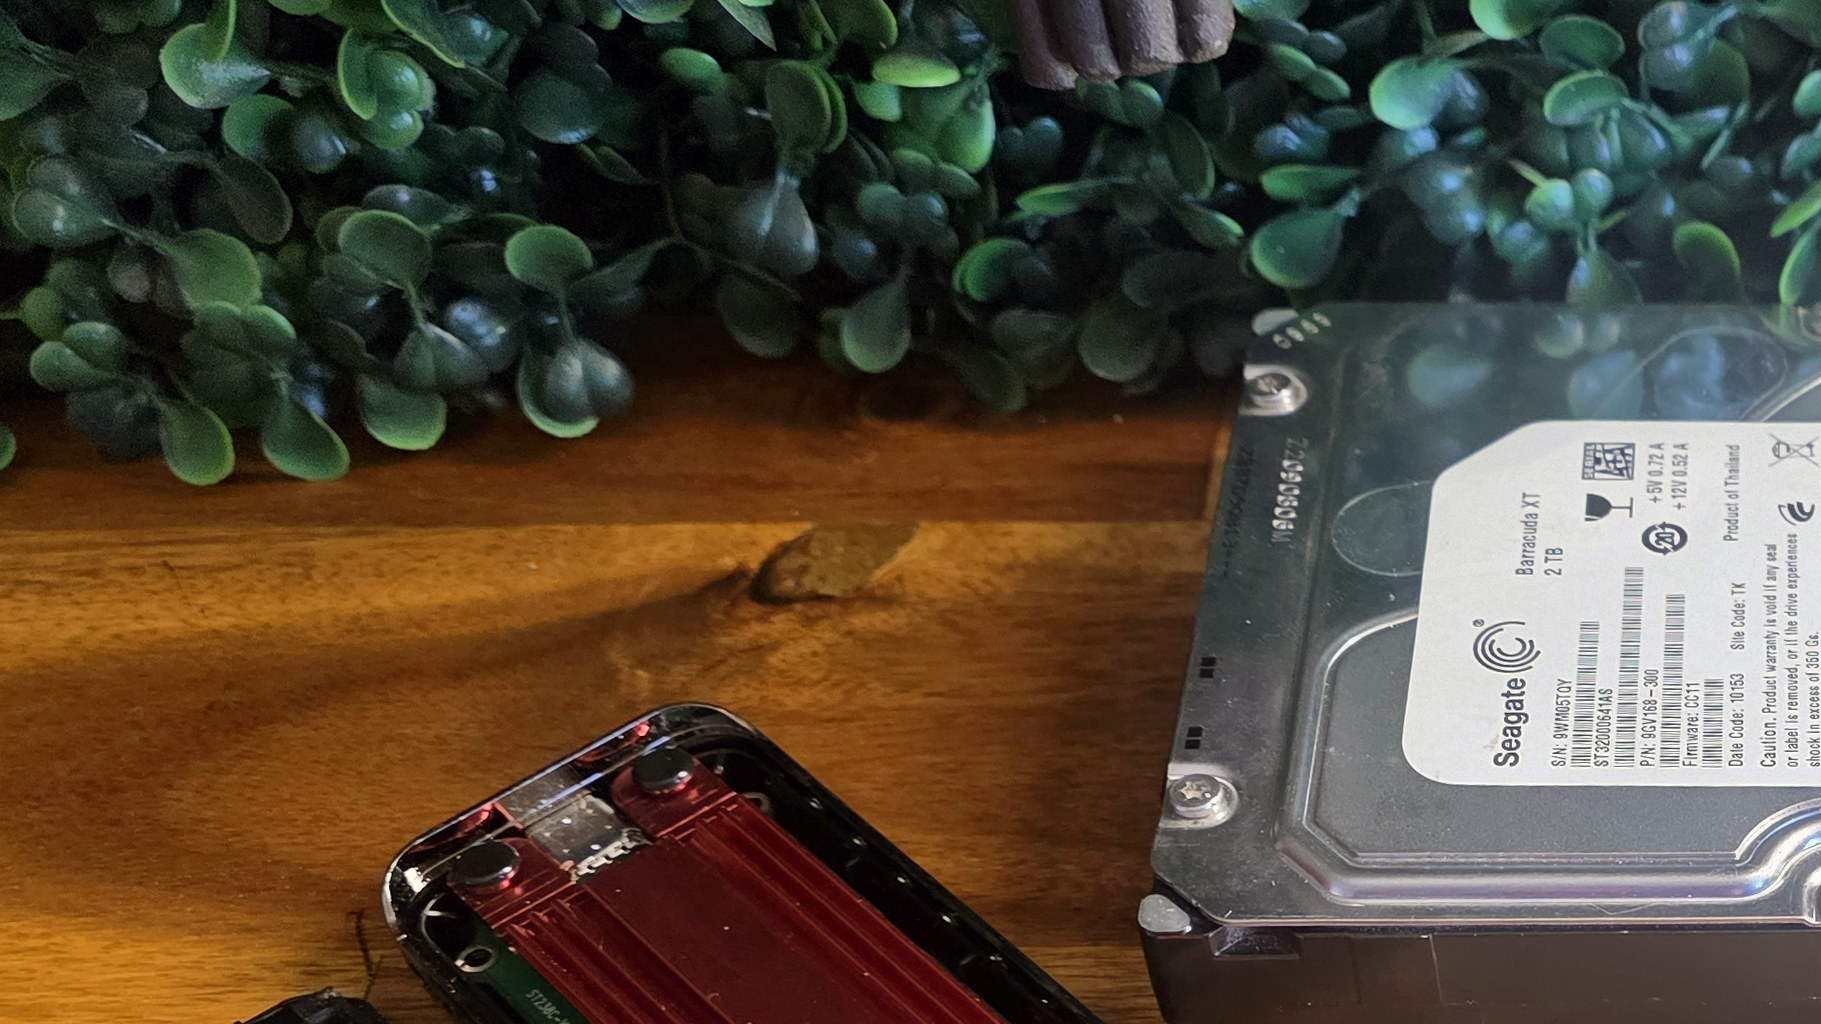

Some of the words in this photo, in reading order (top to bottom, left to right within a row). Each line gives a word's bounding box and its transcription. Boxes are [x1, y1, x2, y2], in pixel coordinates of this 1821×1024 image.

[1647, 452, 1664, 476] 0.72
[1671, 453, 1689, 476] 0.52
[1724, 444, 1740, 486] Thailand
[1521, 491, 1540, 508] XT
[1724, 489, 1739, 498] of
[1722, 502, 1739, 541] Product
[1514, 512, 1539, 575] Barracuda
[1654, 531, 1676, 546] 20
[1544, 546, 1564, 563] TB
[1764, 543, 1777, 561] seal
[1784, 533, 1801, 589] experiences
[1544, 567, 1562, 575] 2
[1766, 564, 1780, 581] any
[1730, 581, 1745, 596] TK
[1729, 598, 1745, 627] Code:
[1764, 594, 1777, 615] void
[1784, 592, 1798, 616] drive
[1764, 617, 1777, 627] is
[1784, 619, 1798, 635] the
[1729, 631, 1745, 650] Site
[1763, 630, 1780, 672] warranty
[1784, 638, 1798, 646] if
[1787, 648, 1798, 660] or
[1728, 672, 1744, 703] 10153
[1784, 663, 1800, 710] removed,
[1805, 671, 1819, 682] of
[1684, 682, 1700, 708] CC11
[1762, 675, 1777, 714] Product
[1808, 684, 1820, 720] excess
[1492, 677, 1529, 766] Seagate
[1593, 687, 1613, 766] ST32000641AS
[1728, 708, 1744, 738] Code:
[1784, 713, 1799, 723] is
[1806, 723, 1820, 733] in
[1683, 712, 1699, 766] Firmware:
[1760, 717, 1777, 767] Caution.
[1784, 726, 1799, 753] label
[1551, 743, 1568, 766] S/N:
[1639, 743, 1655, 766] P/N:
[1727, 742, 1744, 766] Date
[1788, 755, 1799, 767] or
[1806, 736, 1821, 767] shock
